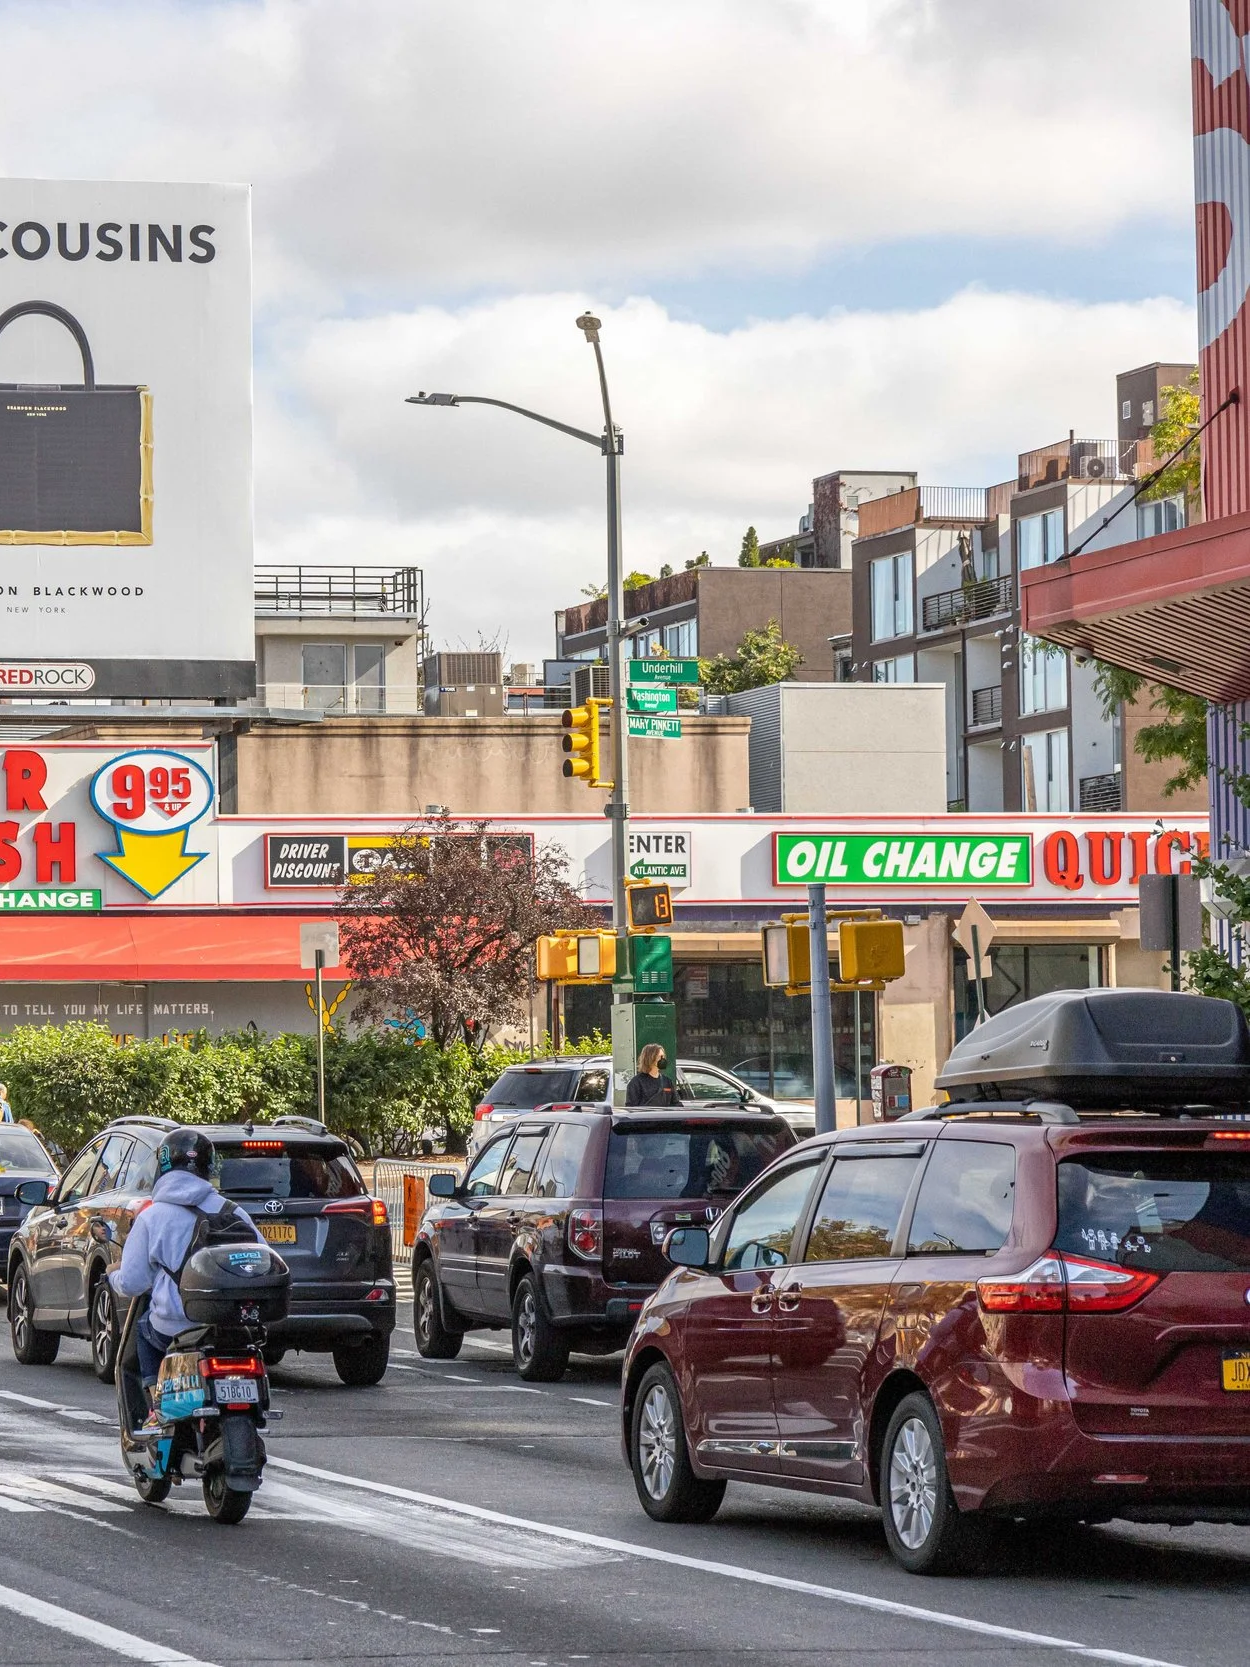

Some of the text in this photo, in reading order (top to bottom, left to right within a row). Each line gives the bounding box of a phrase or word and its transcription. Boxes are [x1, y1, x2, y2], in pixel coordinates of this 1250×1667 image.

[33, 586, 144, 596] BLACKWOOD
[38, 606, 67, 614] YORK
[642, 662, 683, 674] Underhill
[631, 689, 670, 704] Washington
[630, 717, 680, 732] MARY PINKETT
[171, 803, 182, 811] UP
[279, 843, 330, 859] DRIVER
[629, 835, 687, 854] ENTER
[786, 841, 1023, 879] OIL CHANGE
[272, 862, 341, 879] DISCOUNT
[633, 866, 685, 875] ATLANTIC AVE
[655, 893, 669, 918] 13
[3, 1004, 18, 1015] TO
[24, 1004, 54, 1015] TELL
[63, 1004, 85, 1015] YOU
[94, 1004, 109, 1015] MY
[116, 1004, 143, 1015] LIFE
[153, 1003, 215, 1016] MATTERS,
[228, 1251, 262, 1260] revel
